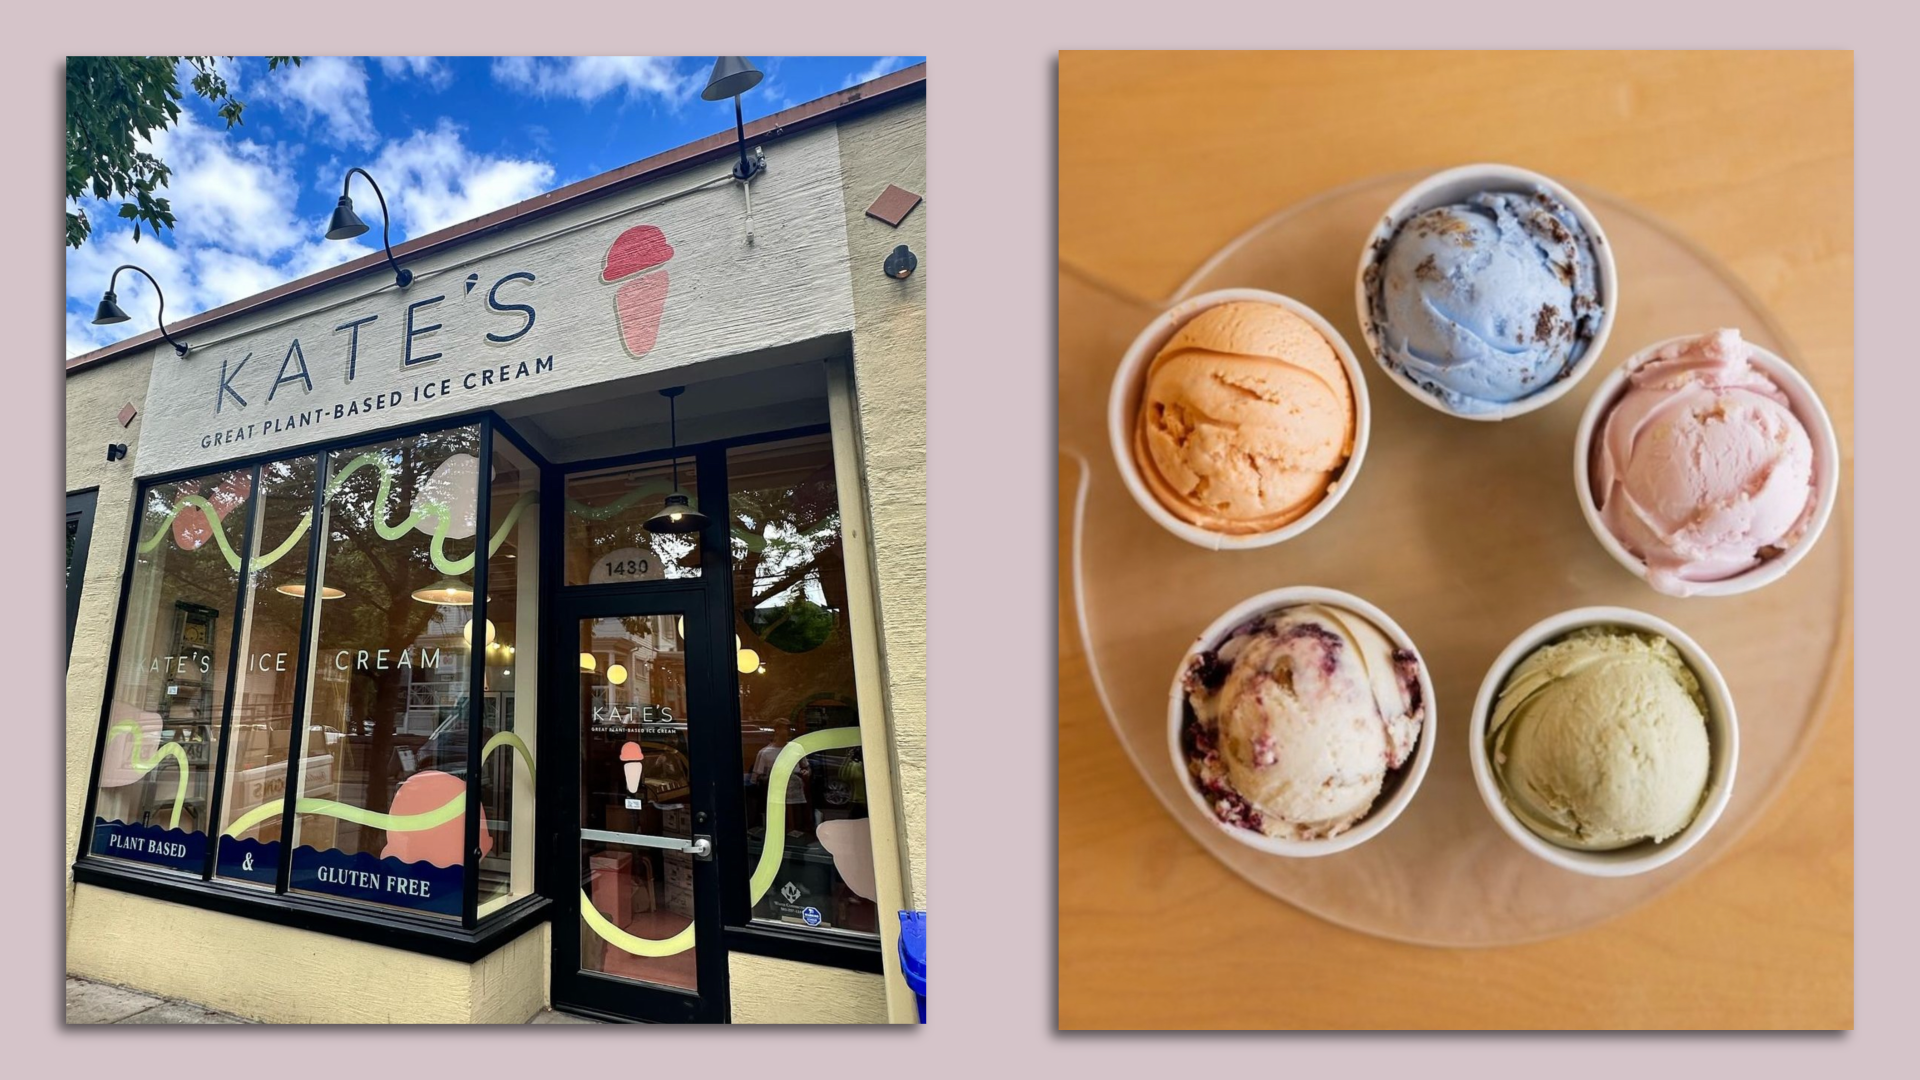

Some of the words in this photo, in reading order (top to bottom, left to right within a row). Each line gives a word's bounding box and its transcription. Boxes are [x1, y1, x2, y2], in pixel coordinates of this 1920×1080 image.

[216, 271, 537, 414] KATE'S
[201, 424, 255, 449] GREAT
[263, 391, 402, 435] PLANT-BASED
[413, 378, 451, 402] ICE
[463, 354, 554, 390] CREAM
[605, 559, 648, 577] 1430
[137, 651, 210, 674] KATE'S
[250, 652, 288, 672] ICE
[335, 647, 440, 671] CREAM
[592, 704, 673, 723] KATE'S
[109, 834, 146, 852] PLANT
[147, 839, 187, 858] BASED
[242, 851, 254, 871] &
[317, 866, 380, 890] GLUTEN
[386, 875, 431, 898] FREE
